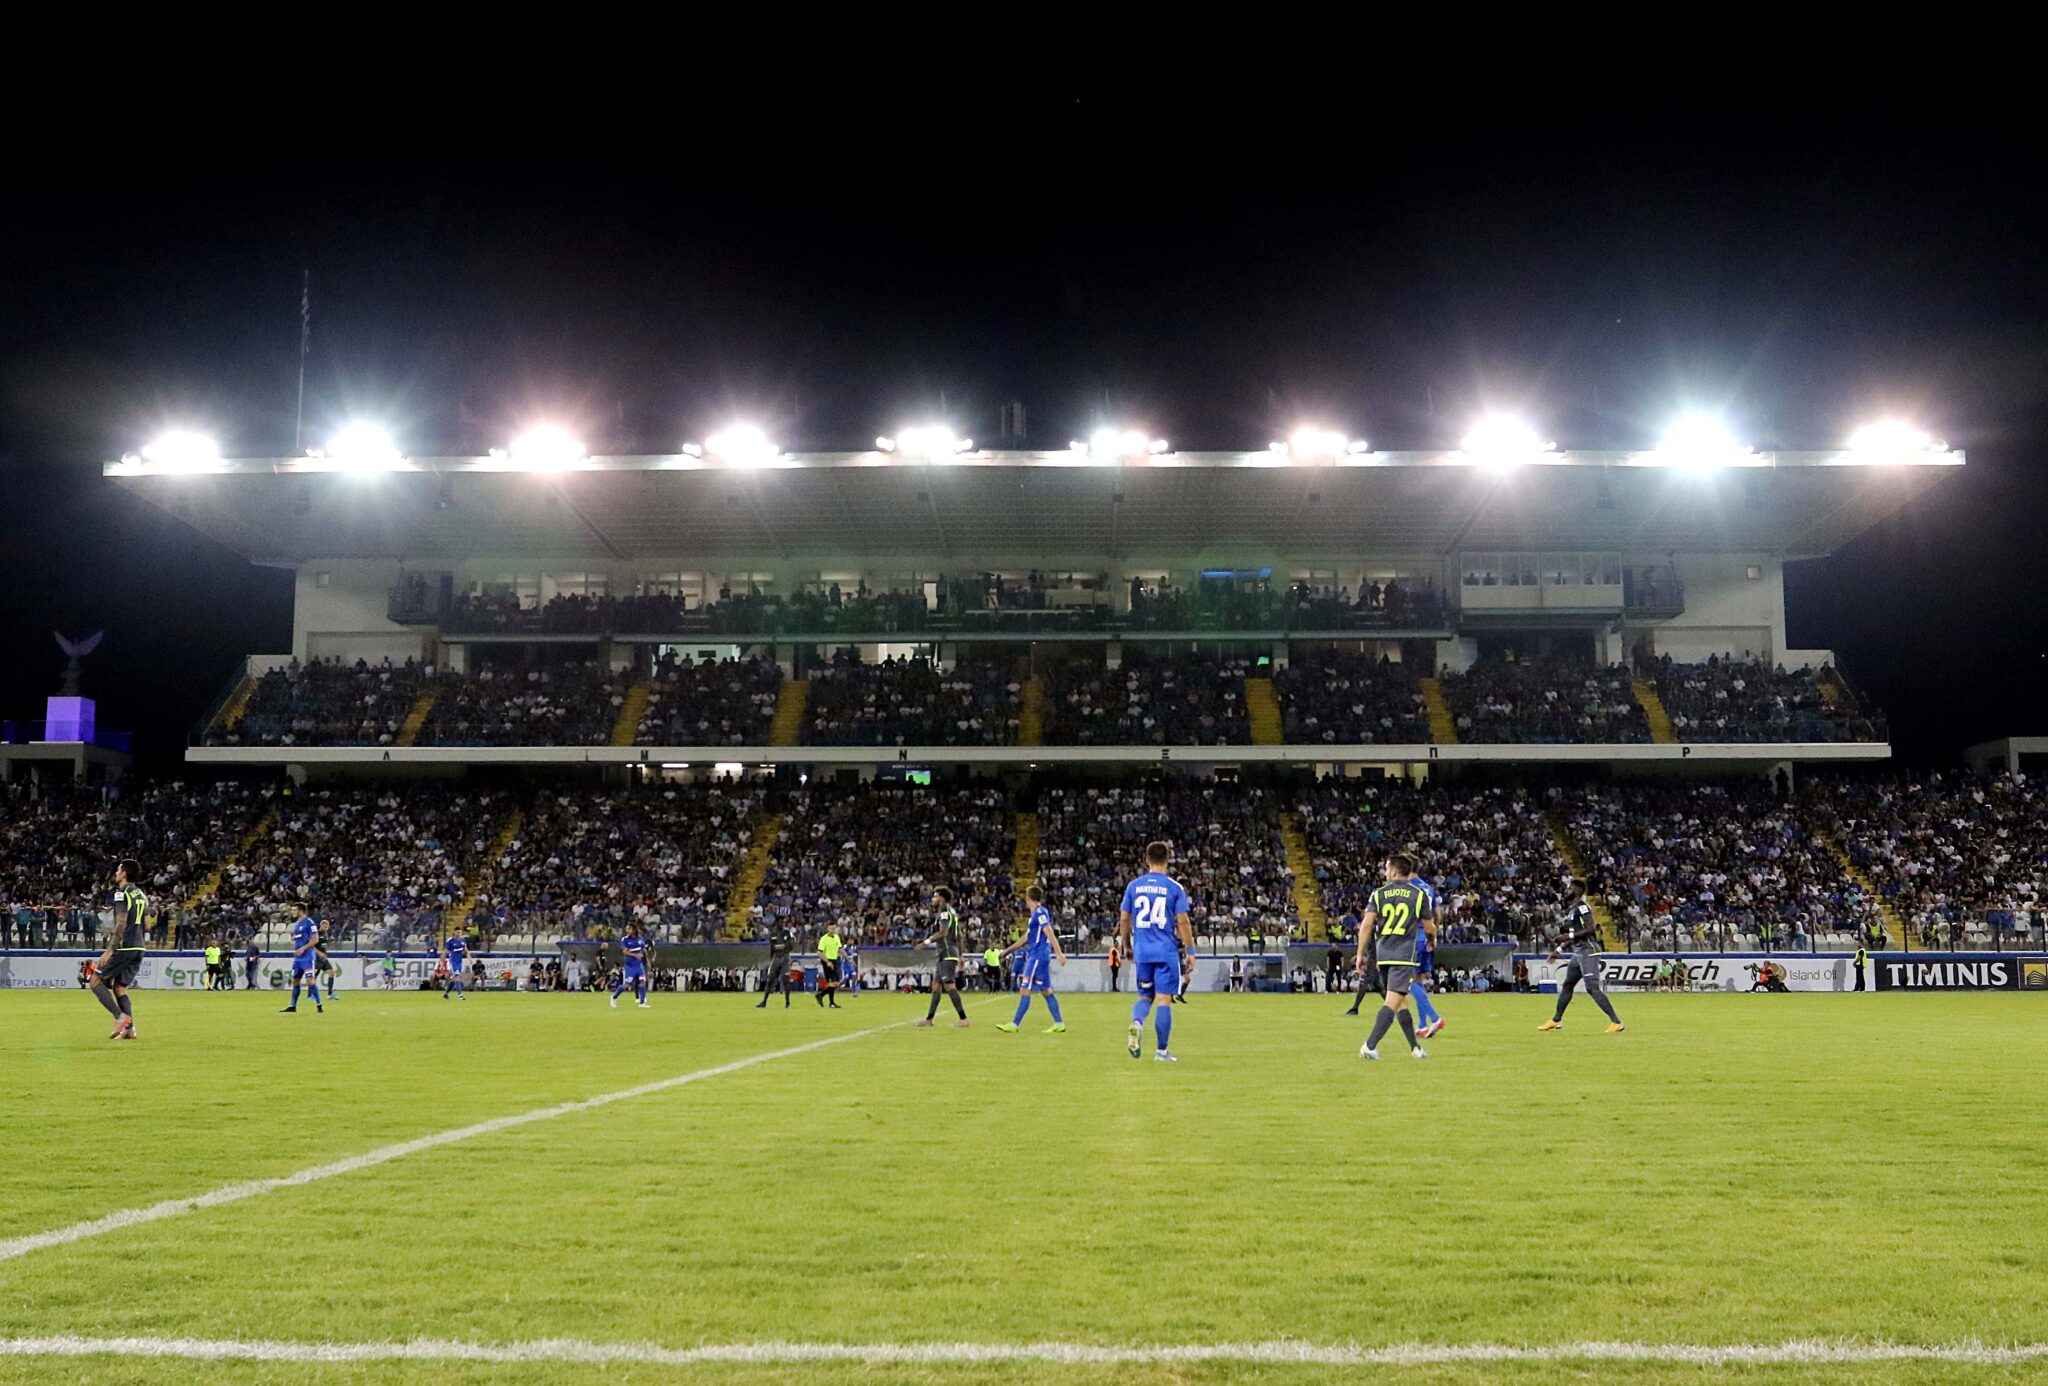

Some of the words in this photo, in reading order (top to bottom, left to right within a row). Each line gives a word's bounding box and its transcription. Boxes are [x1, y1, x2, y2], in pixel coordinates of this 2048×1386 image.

[1384, 888, 1411, 899] FILIOTIS
[135, 899, 145, 924] 17
[1134, 895, 1167, 929] 24
[1381, 902, 1409, 936] 22
[50, 979, 67, 987] LTD
[1790, 969, 1820, 980] Island
[1824, 969, 1837, 980] Oil
[1886, 962, 2008, 986] TIMINIS
